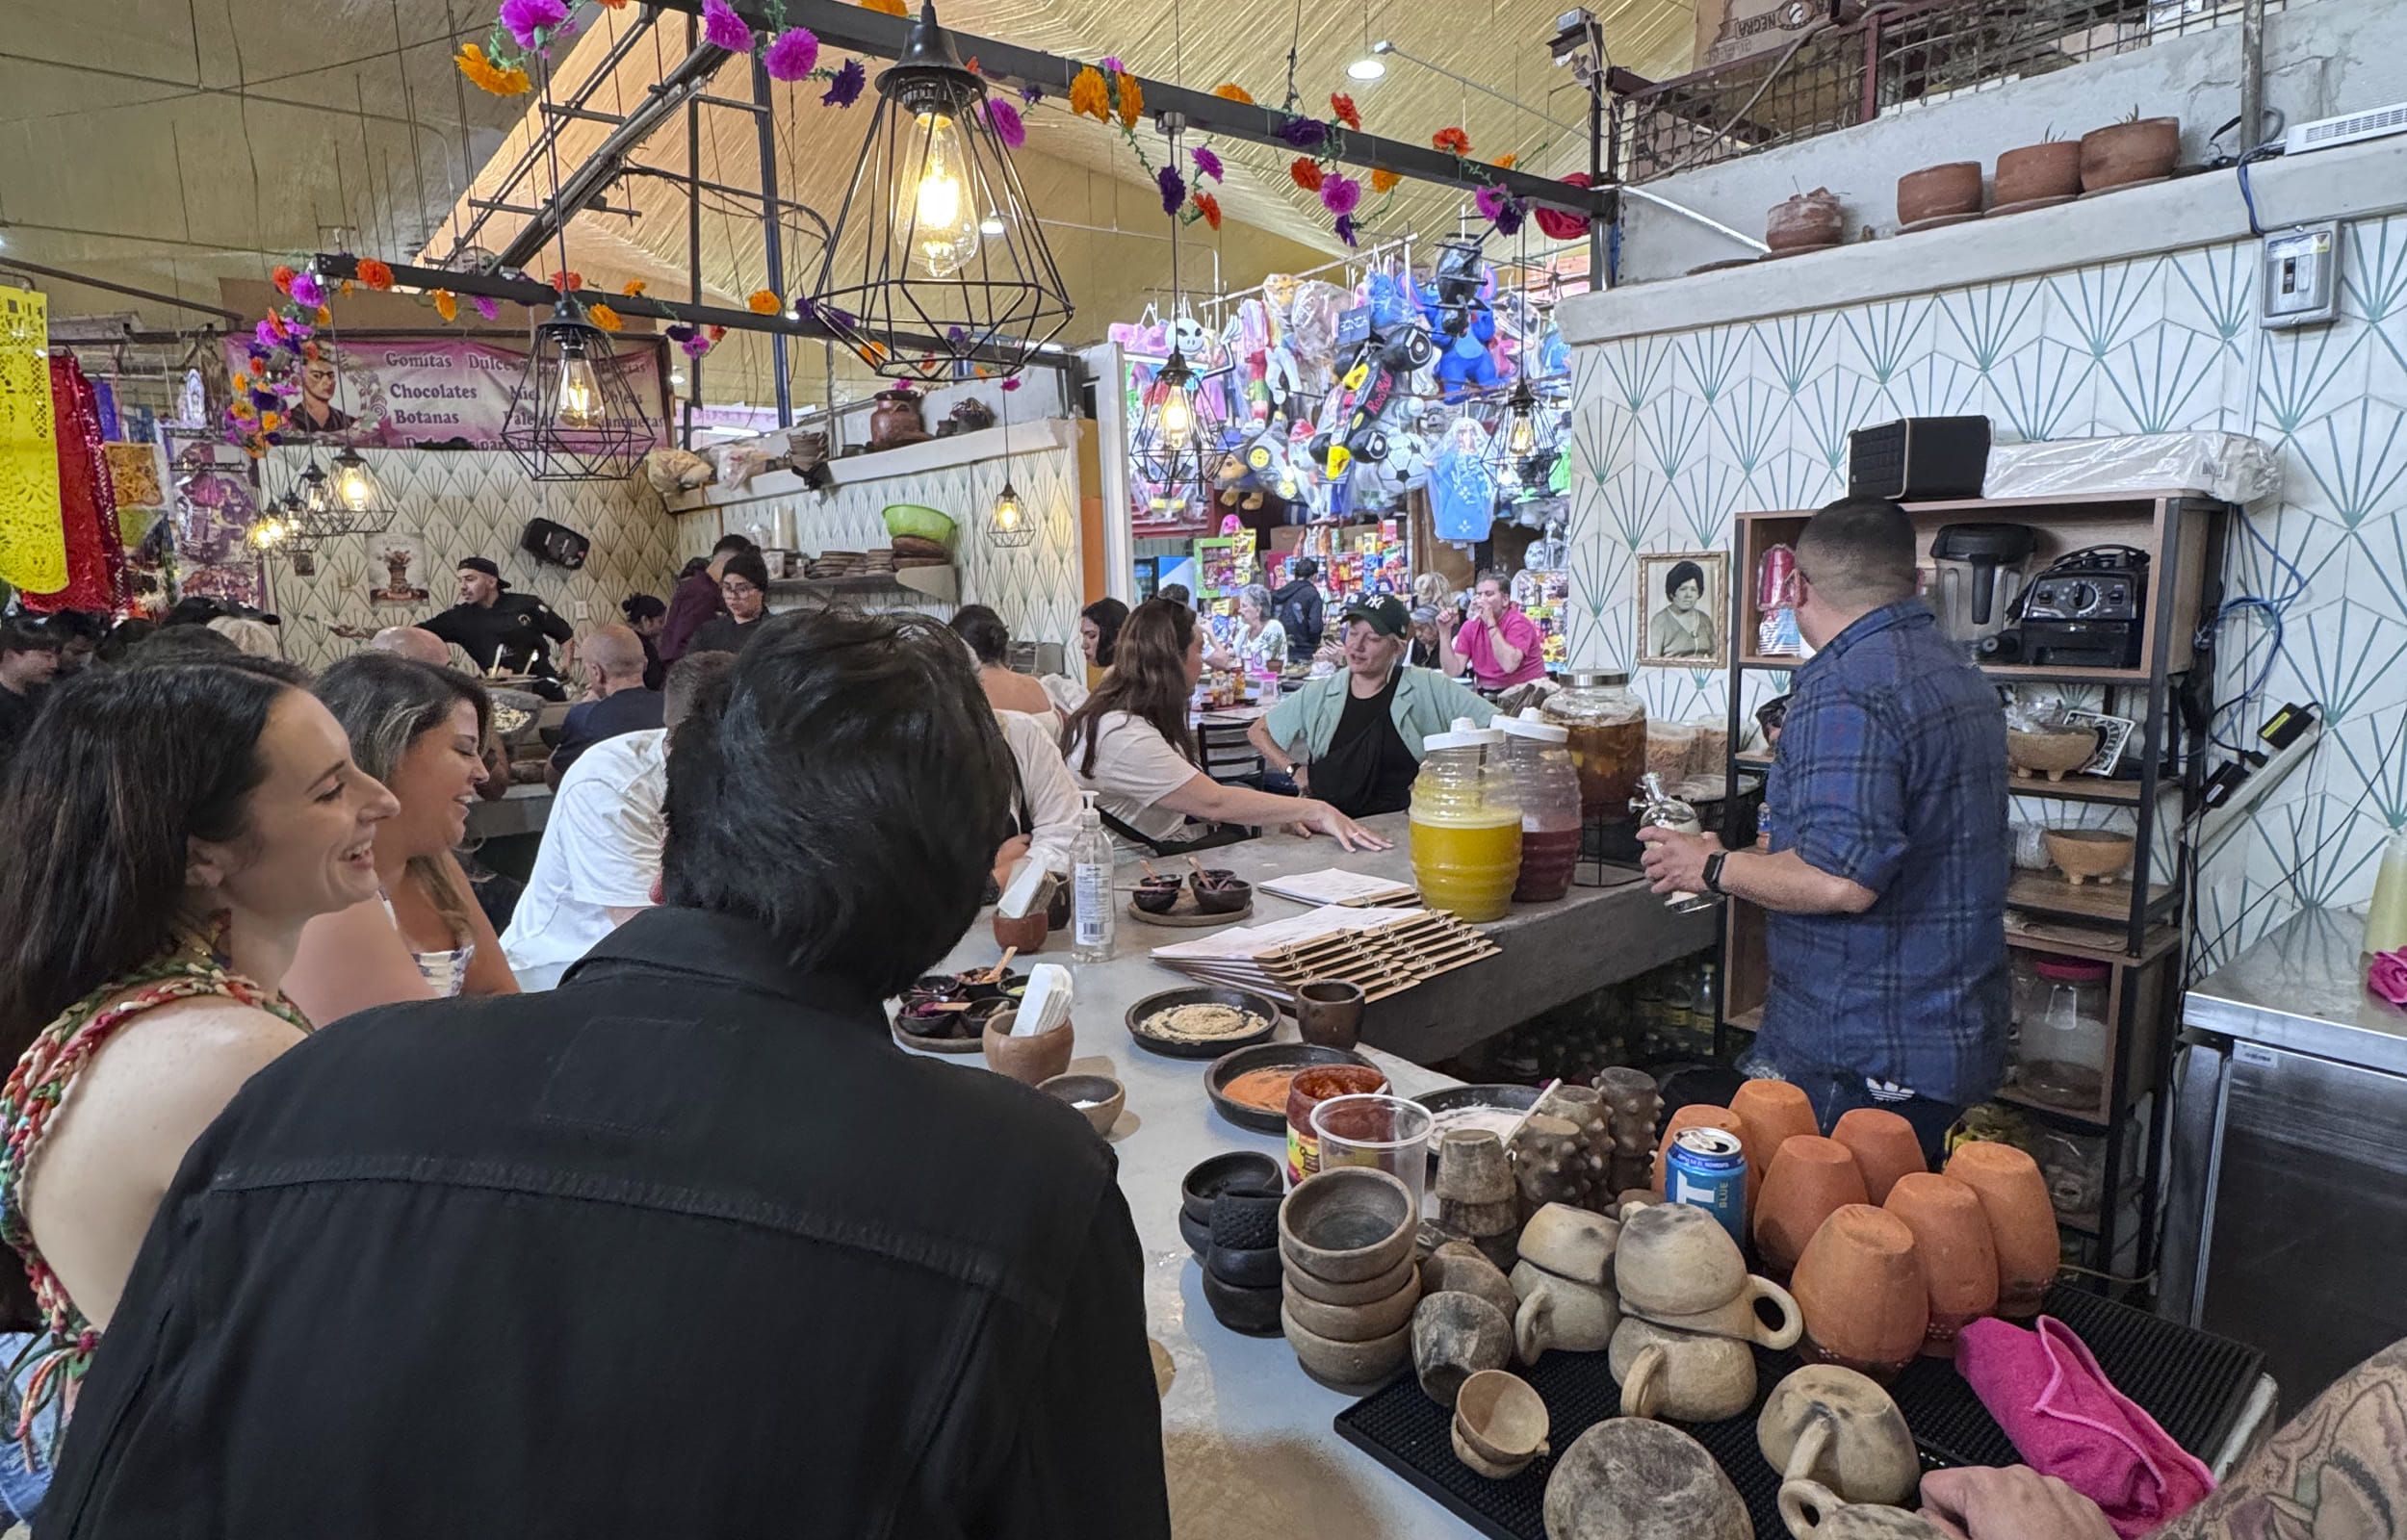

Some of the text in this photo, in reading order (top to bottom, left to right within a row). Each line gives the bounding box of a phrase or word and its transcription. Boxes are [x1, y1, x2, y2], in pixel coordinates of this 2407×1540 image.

[1739, 13, 1775, 36] NEGRA
[385, 351, 453, 369] Gomitas
[389, 383, 478, 399] Chocolates
[394, 409, 460, 424] Botanas
[1719, 1181, 1729, 1209] BLUE
